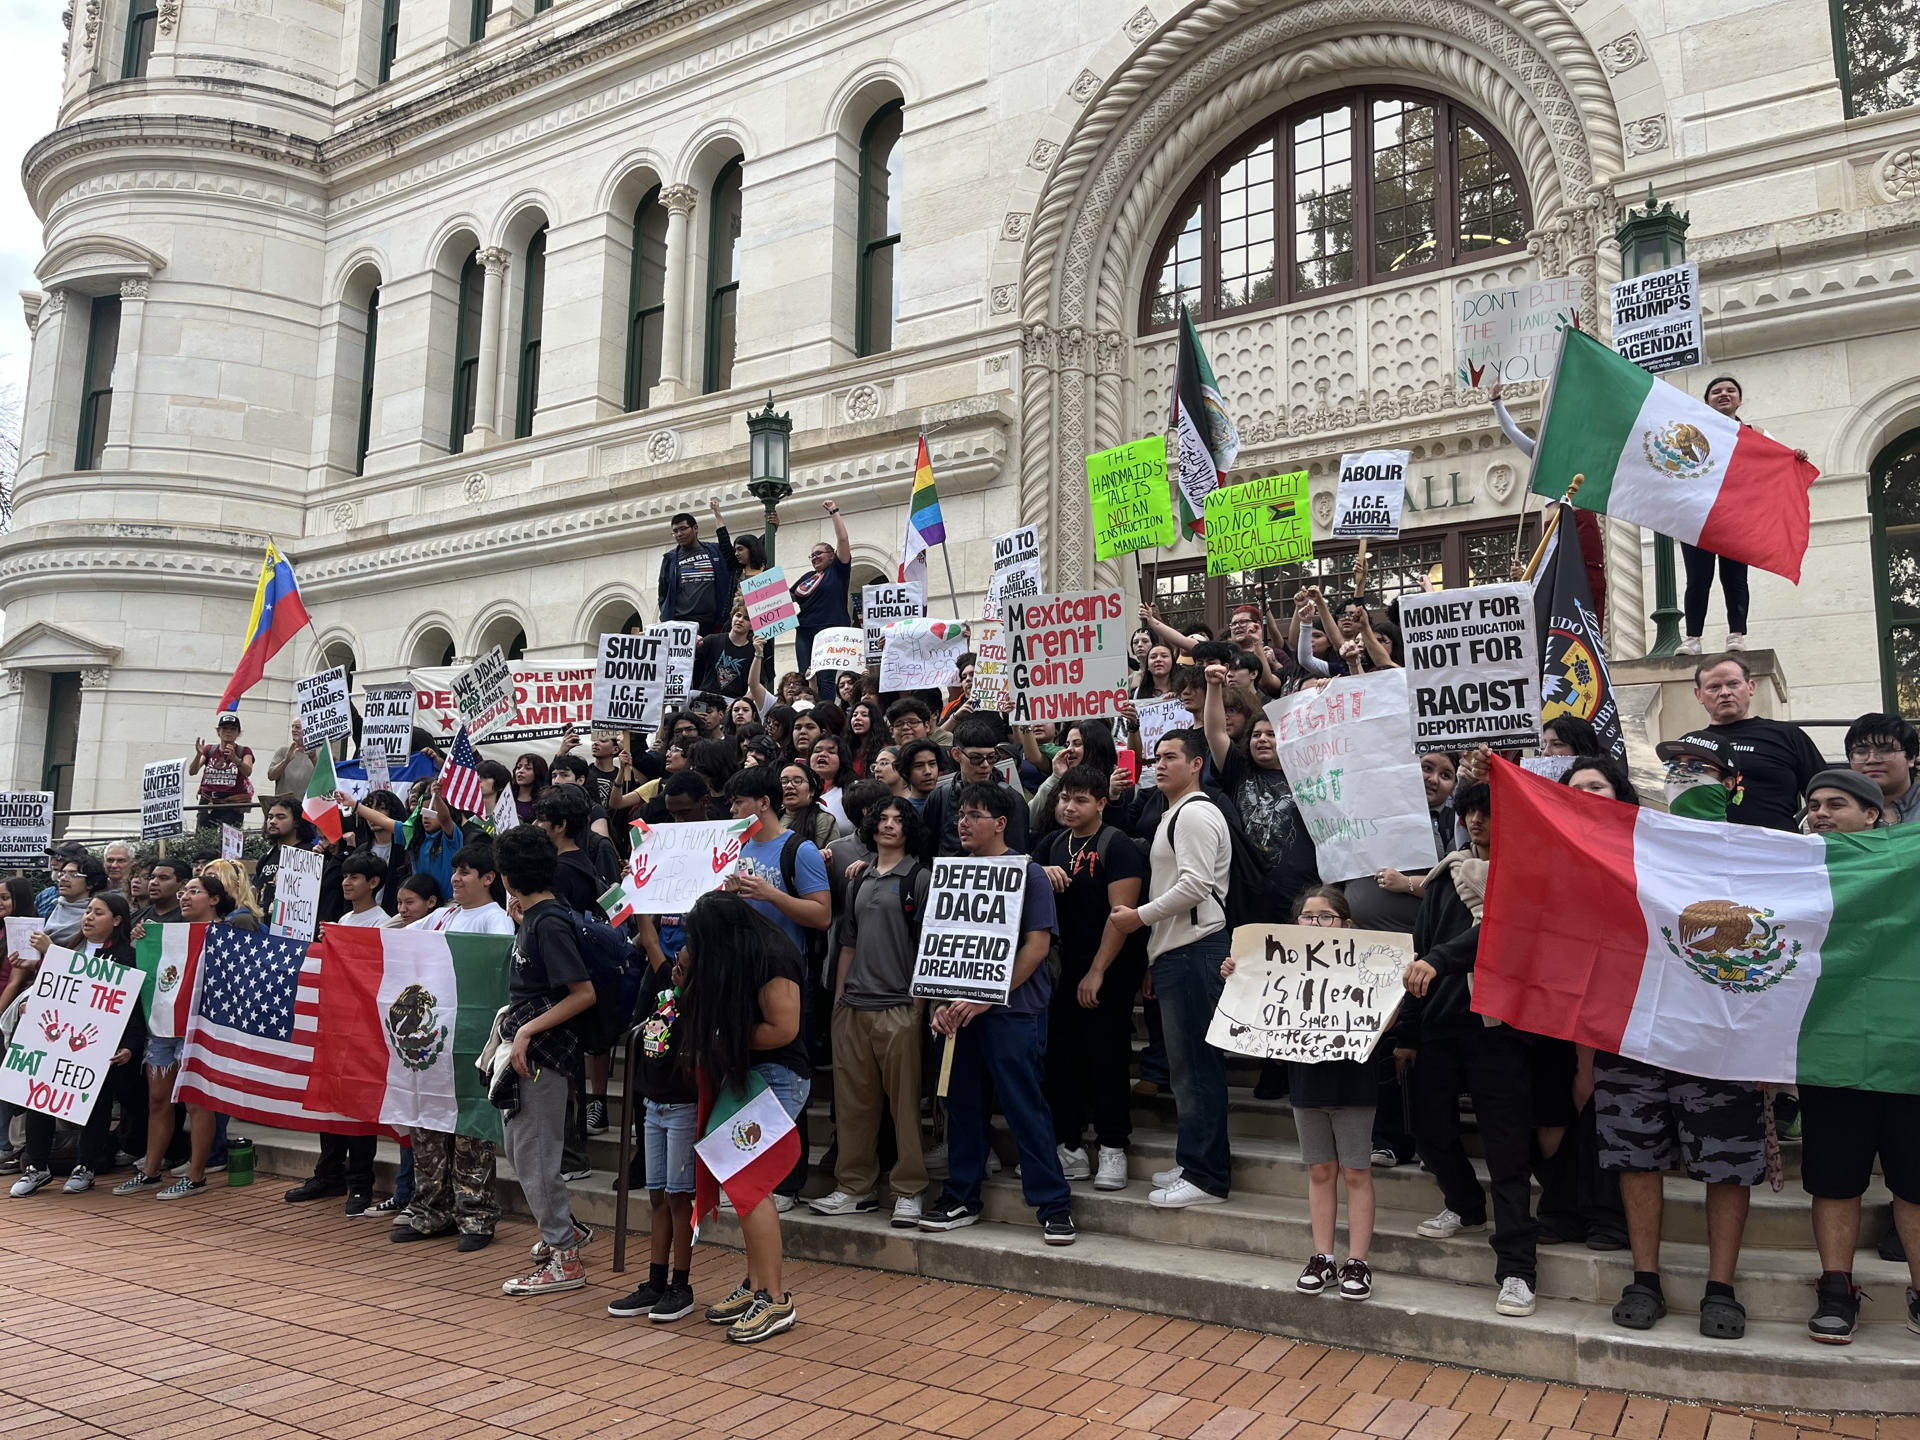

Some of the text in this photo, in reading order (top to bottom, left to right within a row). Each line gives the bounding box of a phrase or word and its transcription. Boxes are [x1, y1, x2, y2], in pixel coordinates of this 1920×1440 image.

[1616, 270, 1689, 298] THE PEOPLE
[1616, 282, 1690, 309] WILL DEFEAT
[1464, 280, 1585, 321] DON'T BITE
[1616, 294, 1691, 325] TRUMP'S
[1461, 309, 1558, 344] THE HANDS
[1617, 320, 1693, 347] EXTREME-RIGHT
[1459, 343, 1502, 364] THAT
[1619, 331, 1693, 360] AGENDA!
[1491, 352, 1556, 380] YOU
[1104, 446, 1137, 466] THE
[1092, 458, 1163, 494] HANDMAID'S
[1341, 464, 1403, 483] ABOLIR
[1103, 480, 1151, 507] TALE IS
[1204, 473, 1302, 511] MY EMPATHY
[1352, 495, 1388, 509] I.C.E.
[1107, 499, 1149, 527] NOT AN
[1232, 507, 1260, 531] NOT
[1341, 510, 1391, 525] AHORA
[1098, 514, 1164, 545] INSTRUCTION
[1206, 517, 1303, 558] RADICALIZE
[996, 530, 1034, 559] NO TO
[1113, 530, 1159, 554] MANUAL!
[994, 547, 1039, 571] DEPORTATIONS
[1210, 557, 1234, 575] ME.
[1000, 576, 1036, 597] FAMILIES
[1006, 569, 1026, 585] KEEP
[875, 588, 910, 605] I.C.E.
[759, 607, 781, 626] NOT
[867, 605, 919, 619] FUERA DE
[1008, 592, 1122, 632] Mexicans
[1403, 596, 1520, 628] MONEY FOR
[673, 628, 691, 646] TO
[761, 621, 786, 639] WAR
[982, 629, 997, 640] IF
[1406, 619, 1525, 644] JOBS AND EDUCATION
[605, 636, 662, 661] SHUT
[827, 646, 857, 656] ALWAYS
[1012, 623, 1103, 663] Aren't!
[1412, 635, 1523, 670] NOT FOR
[604, 660, 657, 681] DOWN
[975, 660, 999, 674] SAVE
[1013, 657, 1084, 690] Going
[297, 668, 343, 693] DETENGAN
[311, 684, 329, 699] LOS
[453, 673, 475, 700] WE
[974, 677, 1000, 691] WILL
[301, 689, 345, 715] ATAQUES
[366, 691, 382, 702] FULL
[383, 690, 412, 701] RIGHTS
[460, 689, 480, 714] CROSS
[468, 703, 481, 720] THE
[481, 686, 505, 711] BORDER
[495, 695, 510, 715] US
[610, 684, 649, 703] I.C.E.
[971, 689, 996, 701] STILL
[1014, 688, 1128, 722] Anywhere
[1416, 678, 1529, 717] RACIST
[307, 707, 337, 726] DE LOS
[364, 702, 409, 718] FOR ALL
[607, 701, 646, 719] NOW
[1137, 706, 1159, 718] WHAT
[1162, 712, 1175, 721] TO
[1279, 690, 1366, 741] FIGHT
[303, 714, 348, 737] DOS PARTIDOS
[308, 723, 348, 742] INMIGRANTES
[1144, 724, 1163, 737] LOVE
[1417, 713, 1533, 737] DEPORTATIONS
[1605, 723, 1617, 738] OF
[1281, 737, 1353, 769] IGNORANCE
[1430, 743, 1446, 752] Party
[1489, 738, 1502, 746] and
[1503, 737, 1537, 746] Liberation
[145, 762, 181, 777] THE PEOPLE
[143, 772, 180, 792] UNITED
[143, 786, 180, 800] WILL DEFEND
[1293, 768, 1343, 806] NOT
[0, 804, 43, 817] UNIDO
[11, 794, 48, 803] PUEBLO
[143, 799, 181, 814] IMMIGRANT
[0, 816, 45, 827] EFENDERÁ
[143, 809, 180, 826] FAMILIES!
[12, 835, 48, 843] FAMILIAS
[651, 828, 729, 851] NO HUMAN
[280, 845, 322, 881] IMMIGRANTS
[664, 854, 689, 878] IS
[283, 873, 302, 898] MAKE
[933, 864, 1024, 892] DEFEND
[285, 899, 312, 925] AMERICA
[934, 892, 1006, 924] DACA
[923, 933, 1011, 962] DEFEND
[918, 958, 1007, 982] DREAMERS
[37, 971, 127, 1014] BITE THE
[923, 986, 935, 995] Party
[977, 991, 1004, 1000] Liberation
[6, 1043, 95, 1090] THAT FEED
[26, 1078, 75, 1116] YOU!
